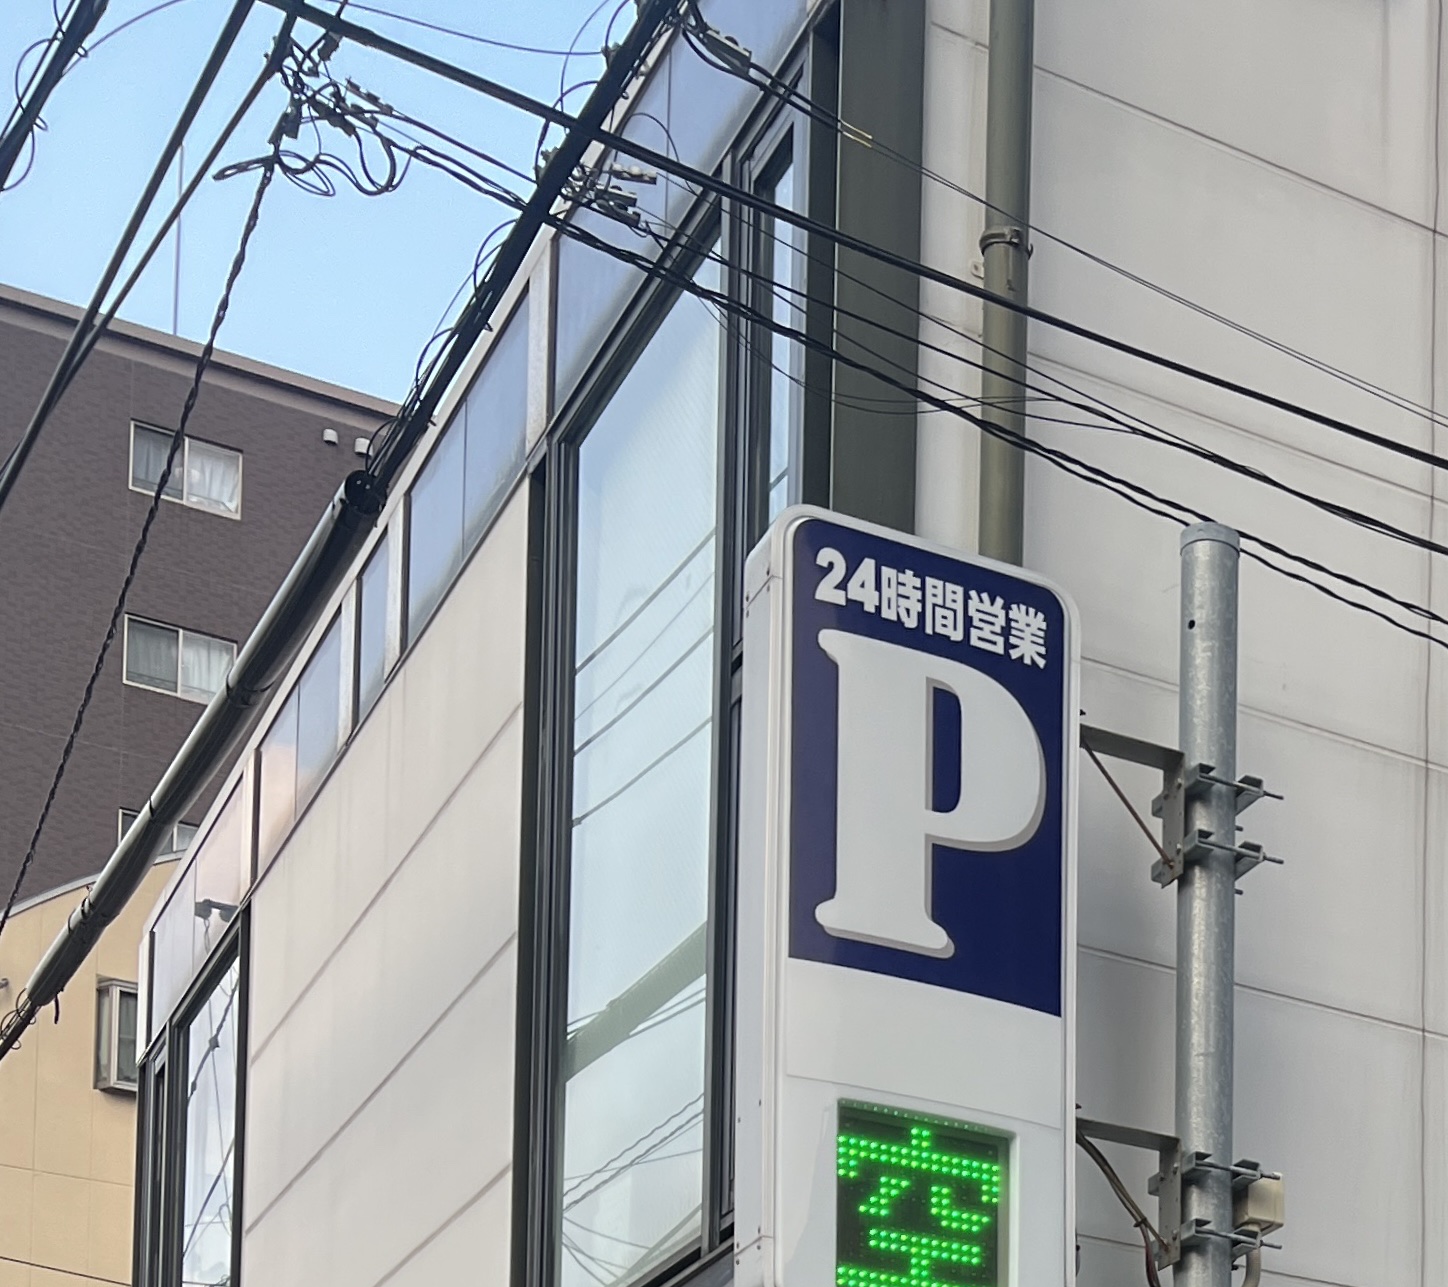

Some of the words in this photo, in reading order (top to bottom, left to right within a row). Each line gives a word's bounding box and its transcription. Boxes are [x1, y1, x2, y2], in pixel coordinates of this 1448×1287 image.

[814, 547, 1048, 669] 24時間営業
[814, 627, 1047, 959] P
